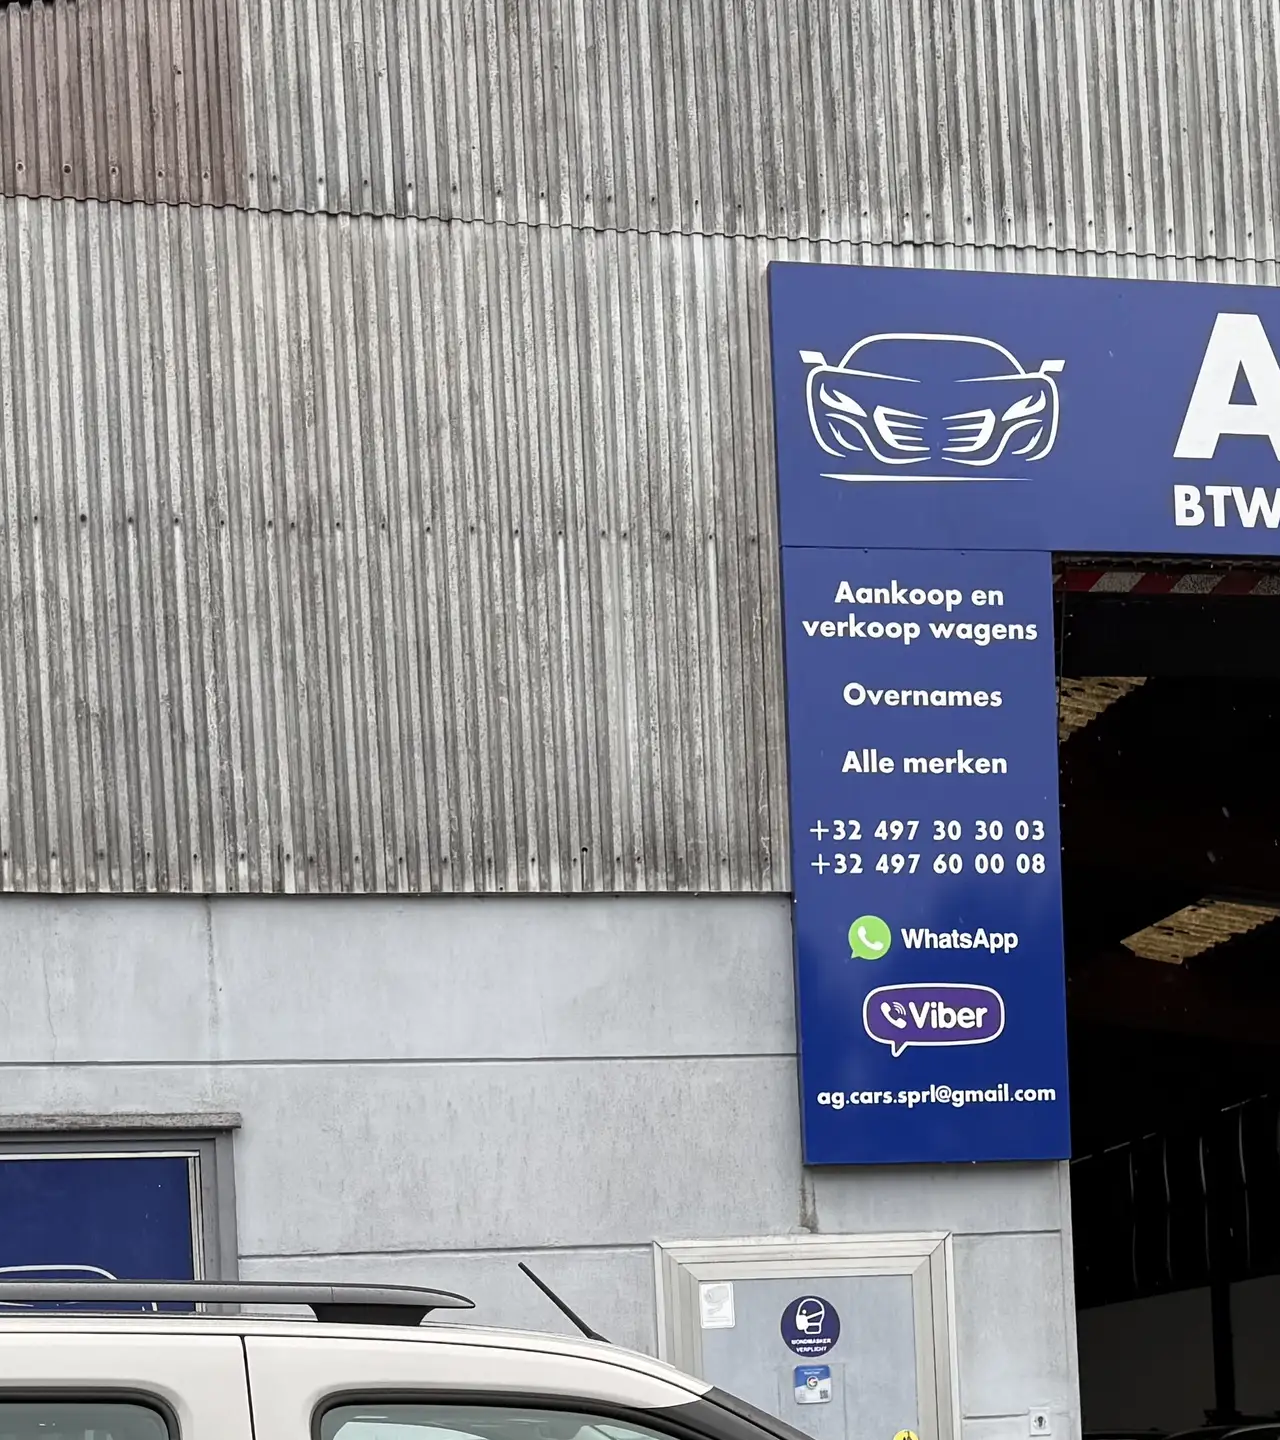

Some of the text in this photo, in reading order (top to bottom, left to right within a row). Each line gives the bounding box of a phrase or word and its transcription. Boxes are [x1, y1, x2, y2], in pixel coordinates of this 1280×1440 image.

[834, 580, 1004, 612] Aankoop en
[802, 613, 1038, 646] verkoop wagens
[843, 682, 1003, 707] Overnames
[841, 749, 1008, 774] Alle merken
[809, 819, 1046, 841] +32 497 30 30 03
[810, 853, 1046, 875] +32 497 60 00 08
[900, 928, 1019, 954] WhatsApp
[908, 1001, 988, 1029] Viber
[816, 1083, 1056, 1110] ag.cars.sprl@gmail.com
